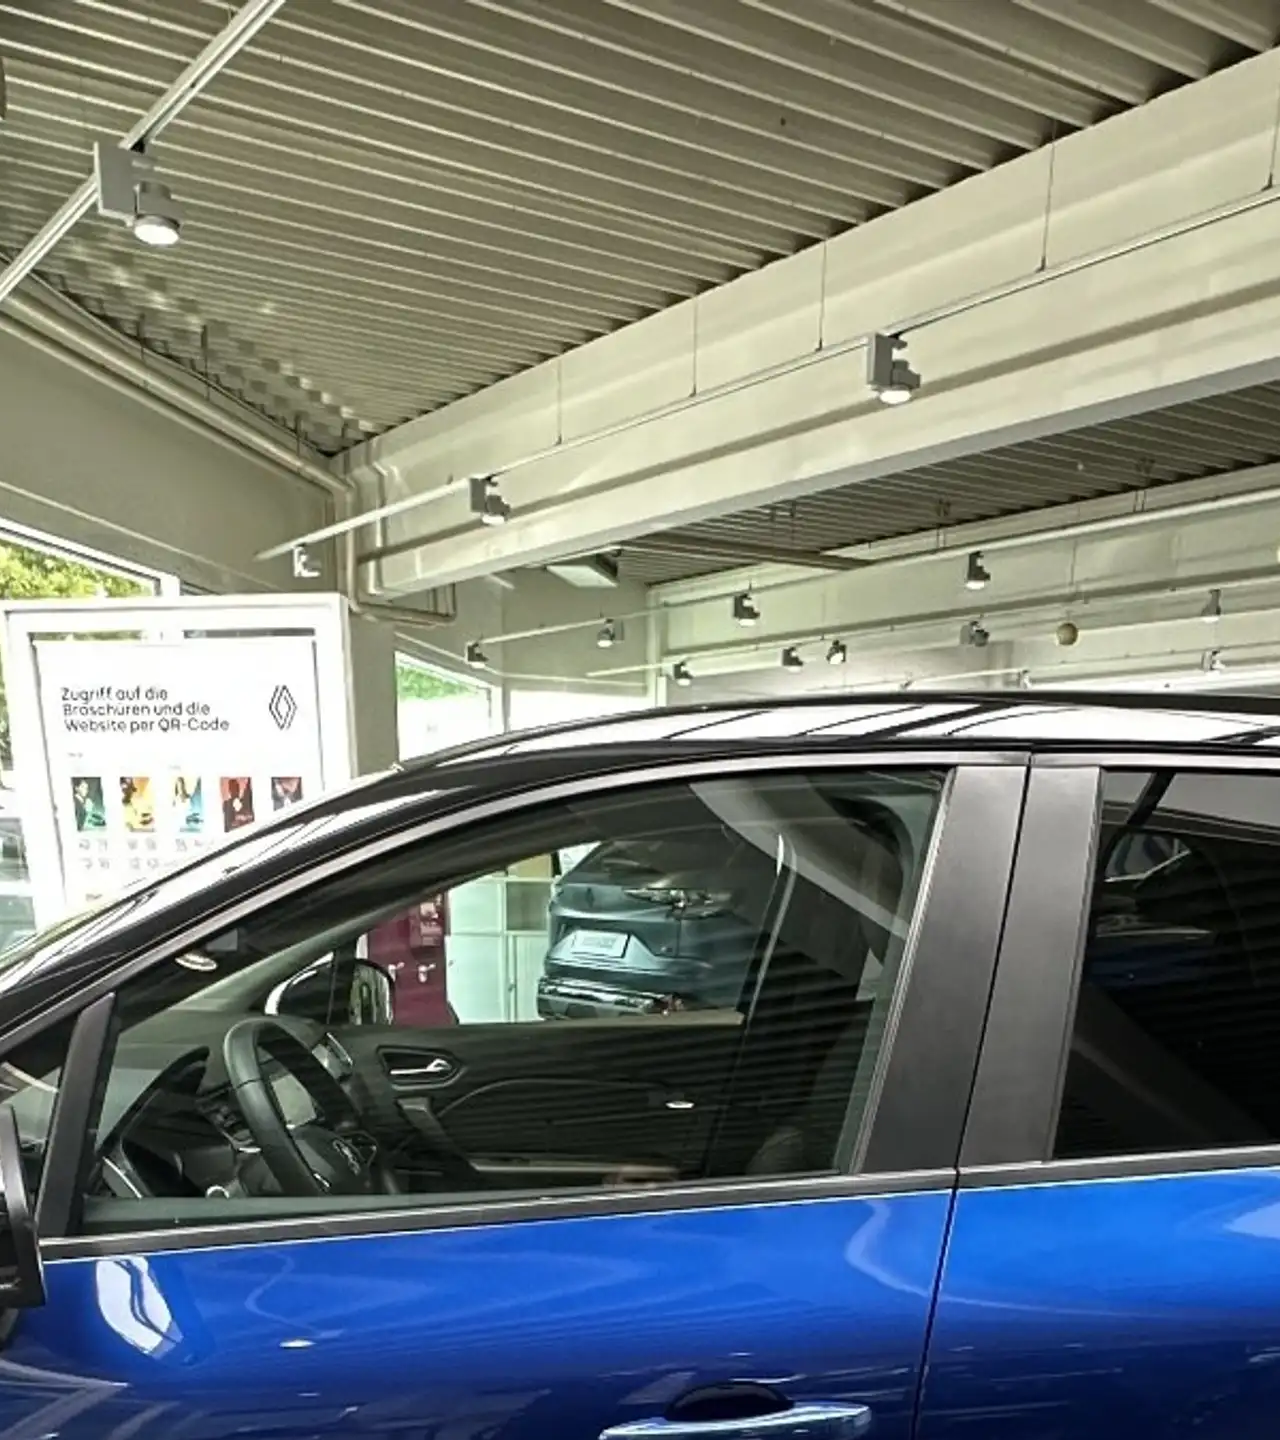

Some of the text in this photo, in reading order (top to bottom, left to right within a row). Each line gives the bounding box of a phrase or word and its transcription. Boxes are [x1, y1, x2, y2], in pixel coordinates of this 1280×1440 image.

[61, 685, 168, 704] Zugriff auf die
[153, 702, 183, 716] und
[185, 702, 211, 716] die
[64, 717, 230, 735] Website per QR-Code
